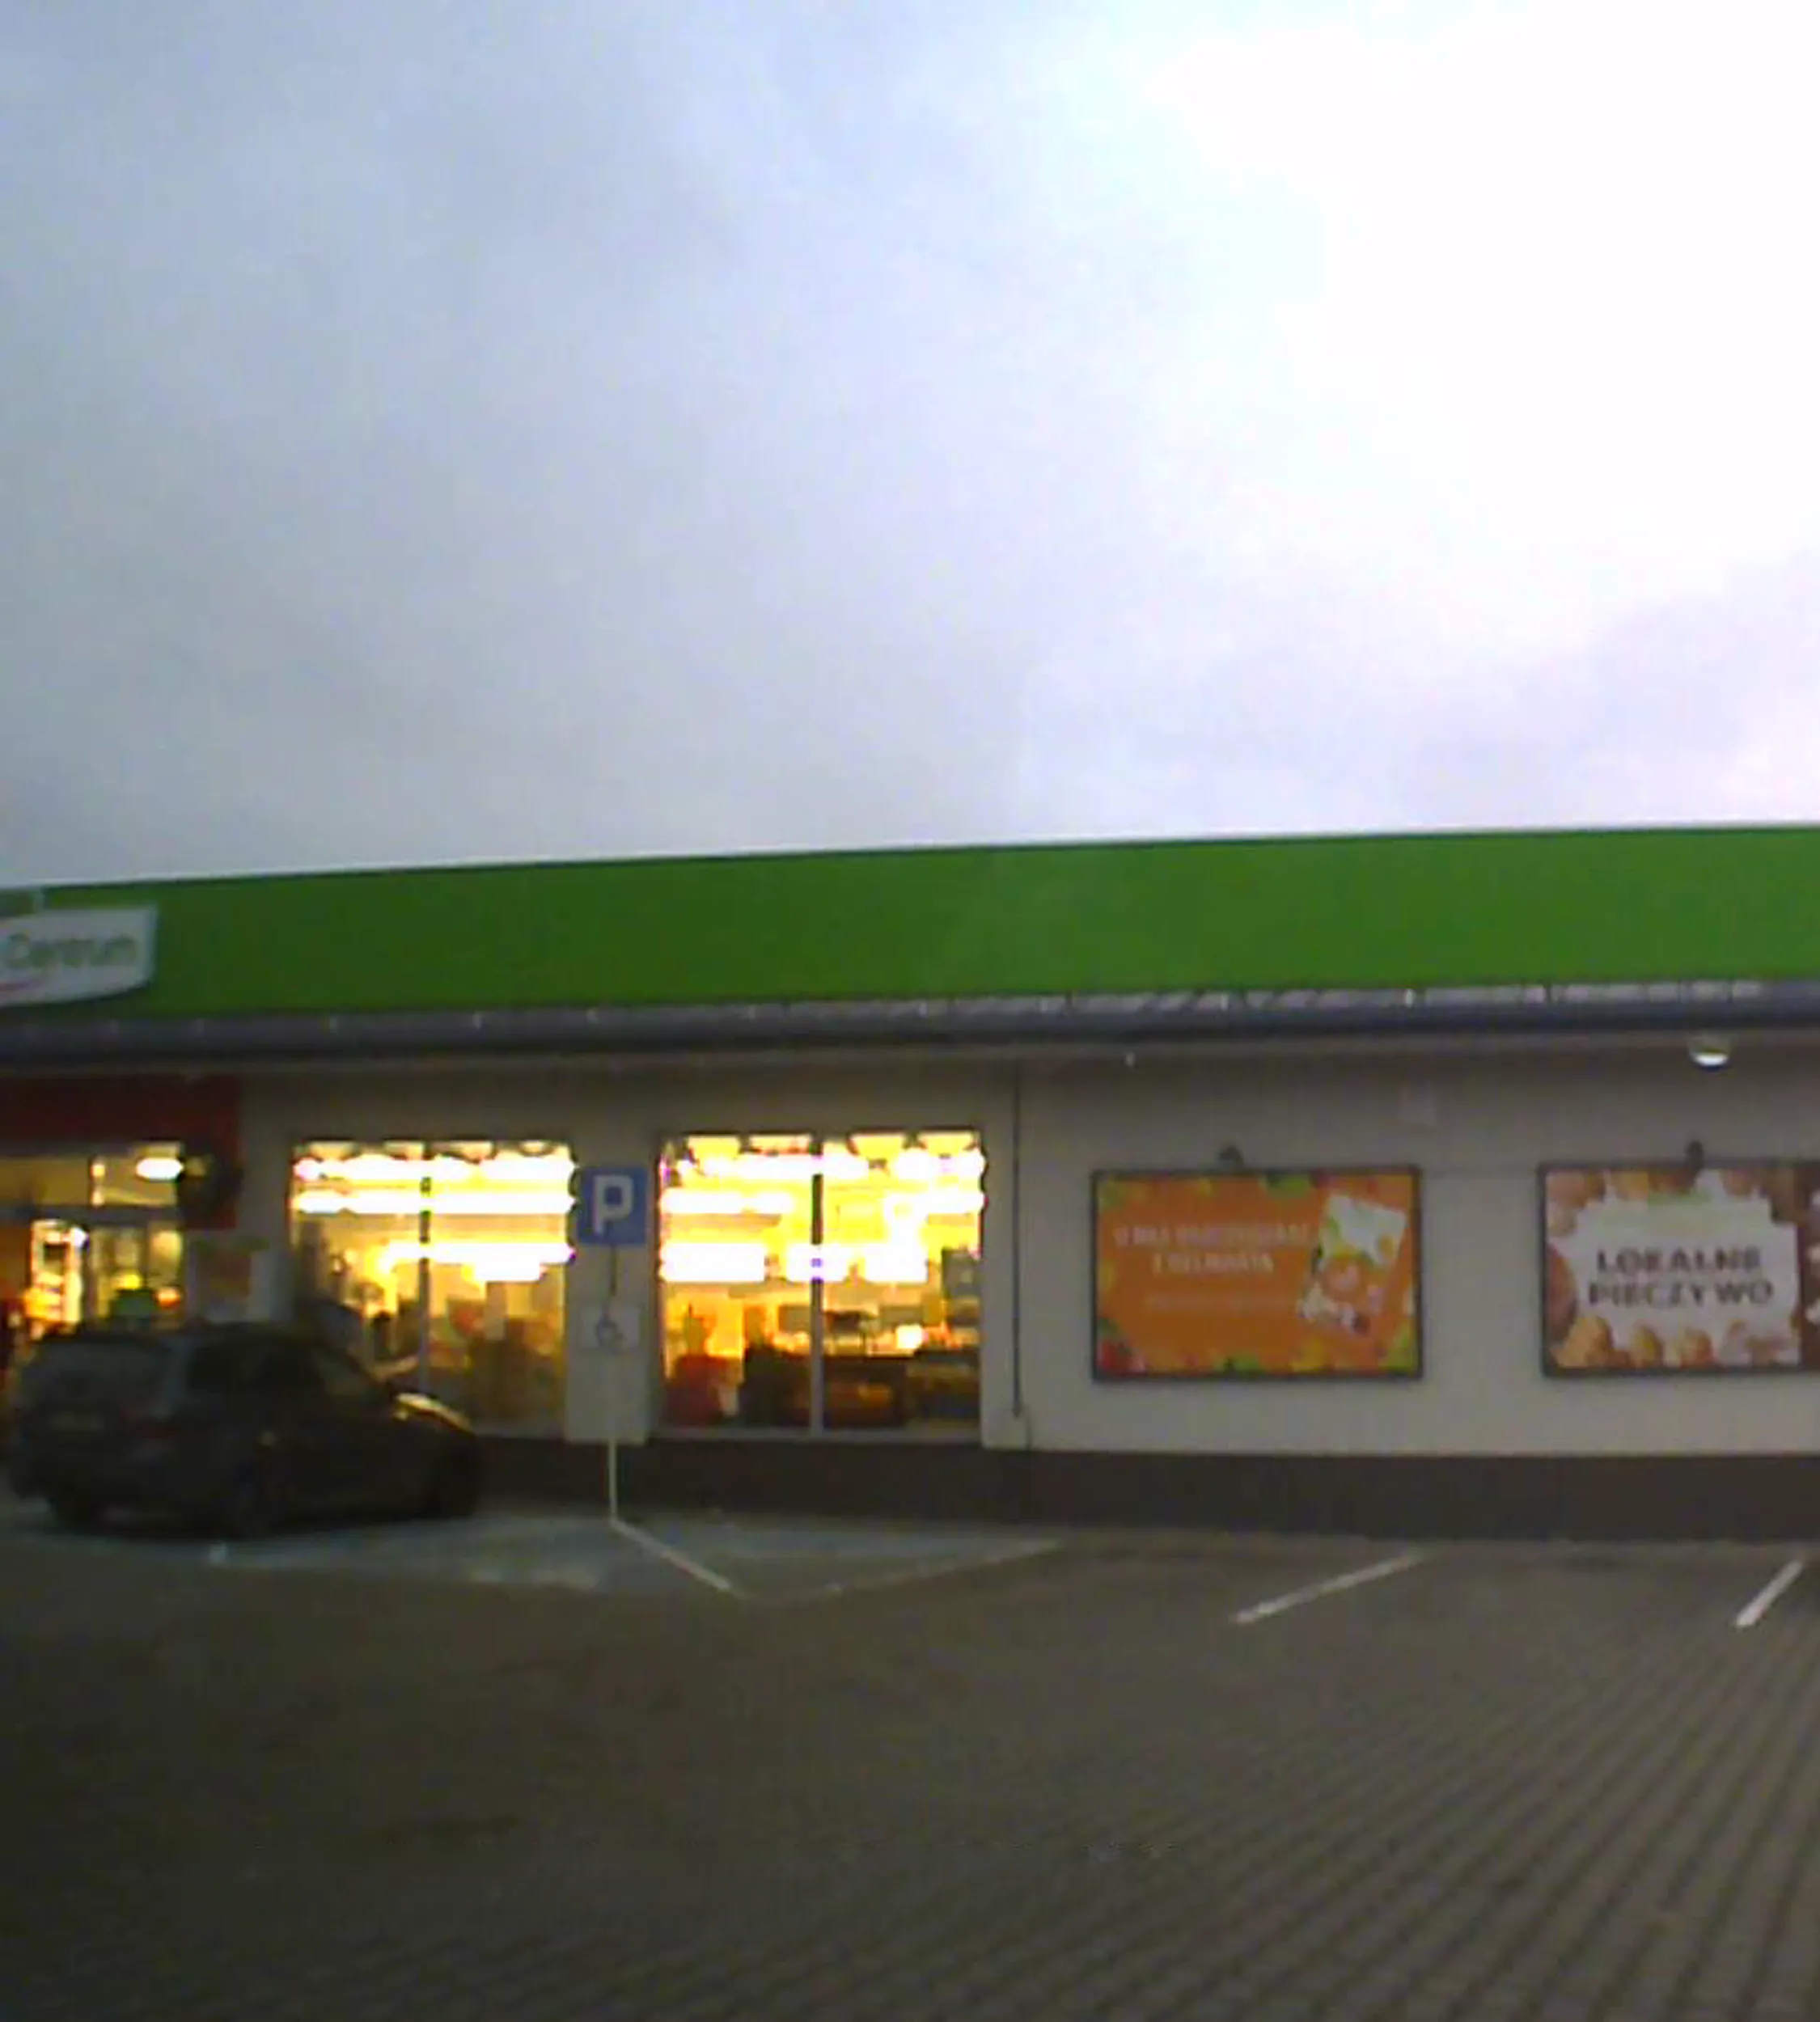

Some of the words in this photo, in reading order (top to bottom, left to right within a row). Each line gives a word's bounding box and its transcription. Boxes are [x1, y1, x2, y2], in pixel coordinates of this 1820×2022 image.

[5, 931, 138, 969] Centrum
[594, 1174, 634, 1235] P
[1597, 1246, 1762, 1272] LOKALNE
[1589, 1279, 1775, 1307] PIECZYWO
